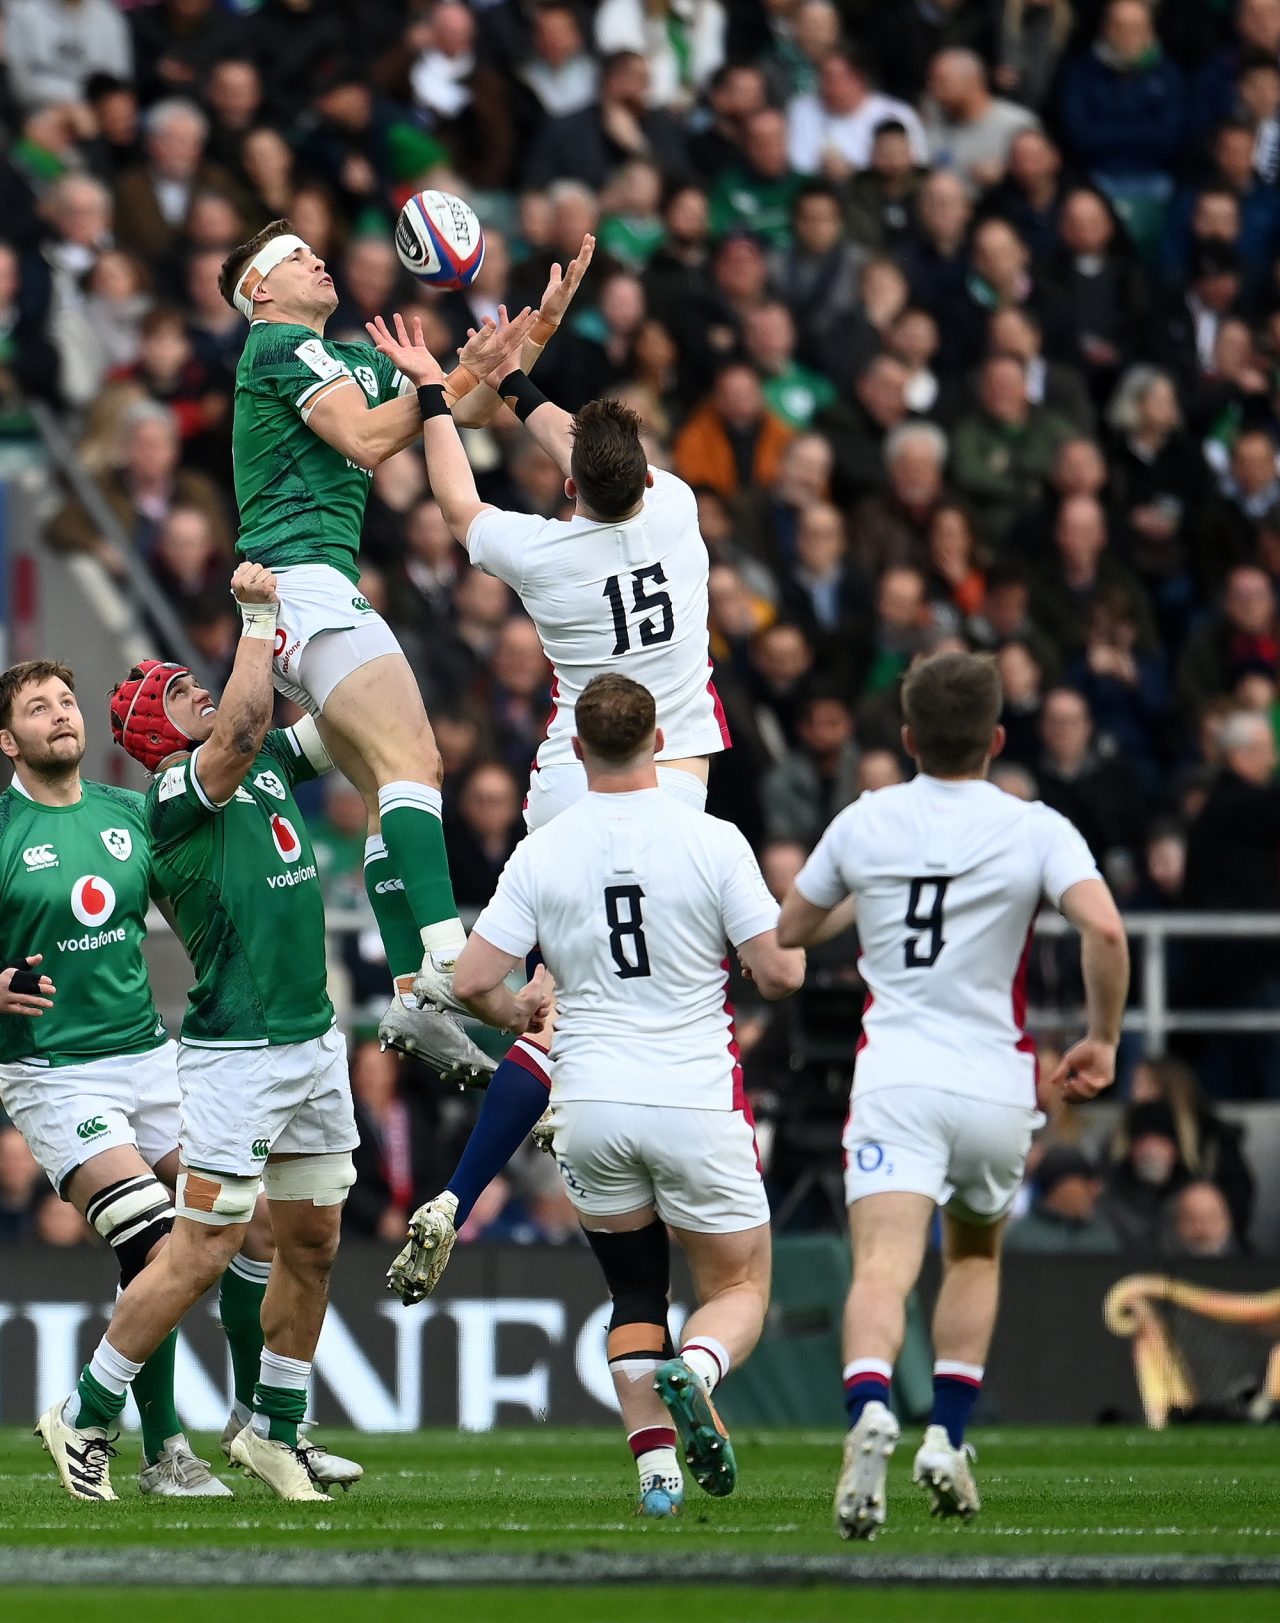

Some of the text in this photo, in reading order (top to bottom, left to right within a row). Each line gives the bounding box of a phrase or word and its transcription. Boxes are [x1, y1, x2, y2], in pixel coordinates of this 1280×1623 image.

[602, 561, 675, 656] 15
[266, 864, 318, 890] vodafone
[904, 875, 952, 969] 9
[56, 927, 127, 953] vodafone
[604, 884, 652, 980] 8
